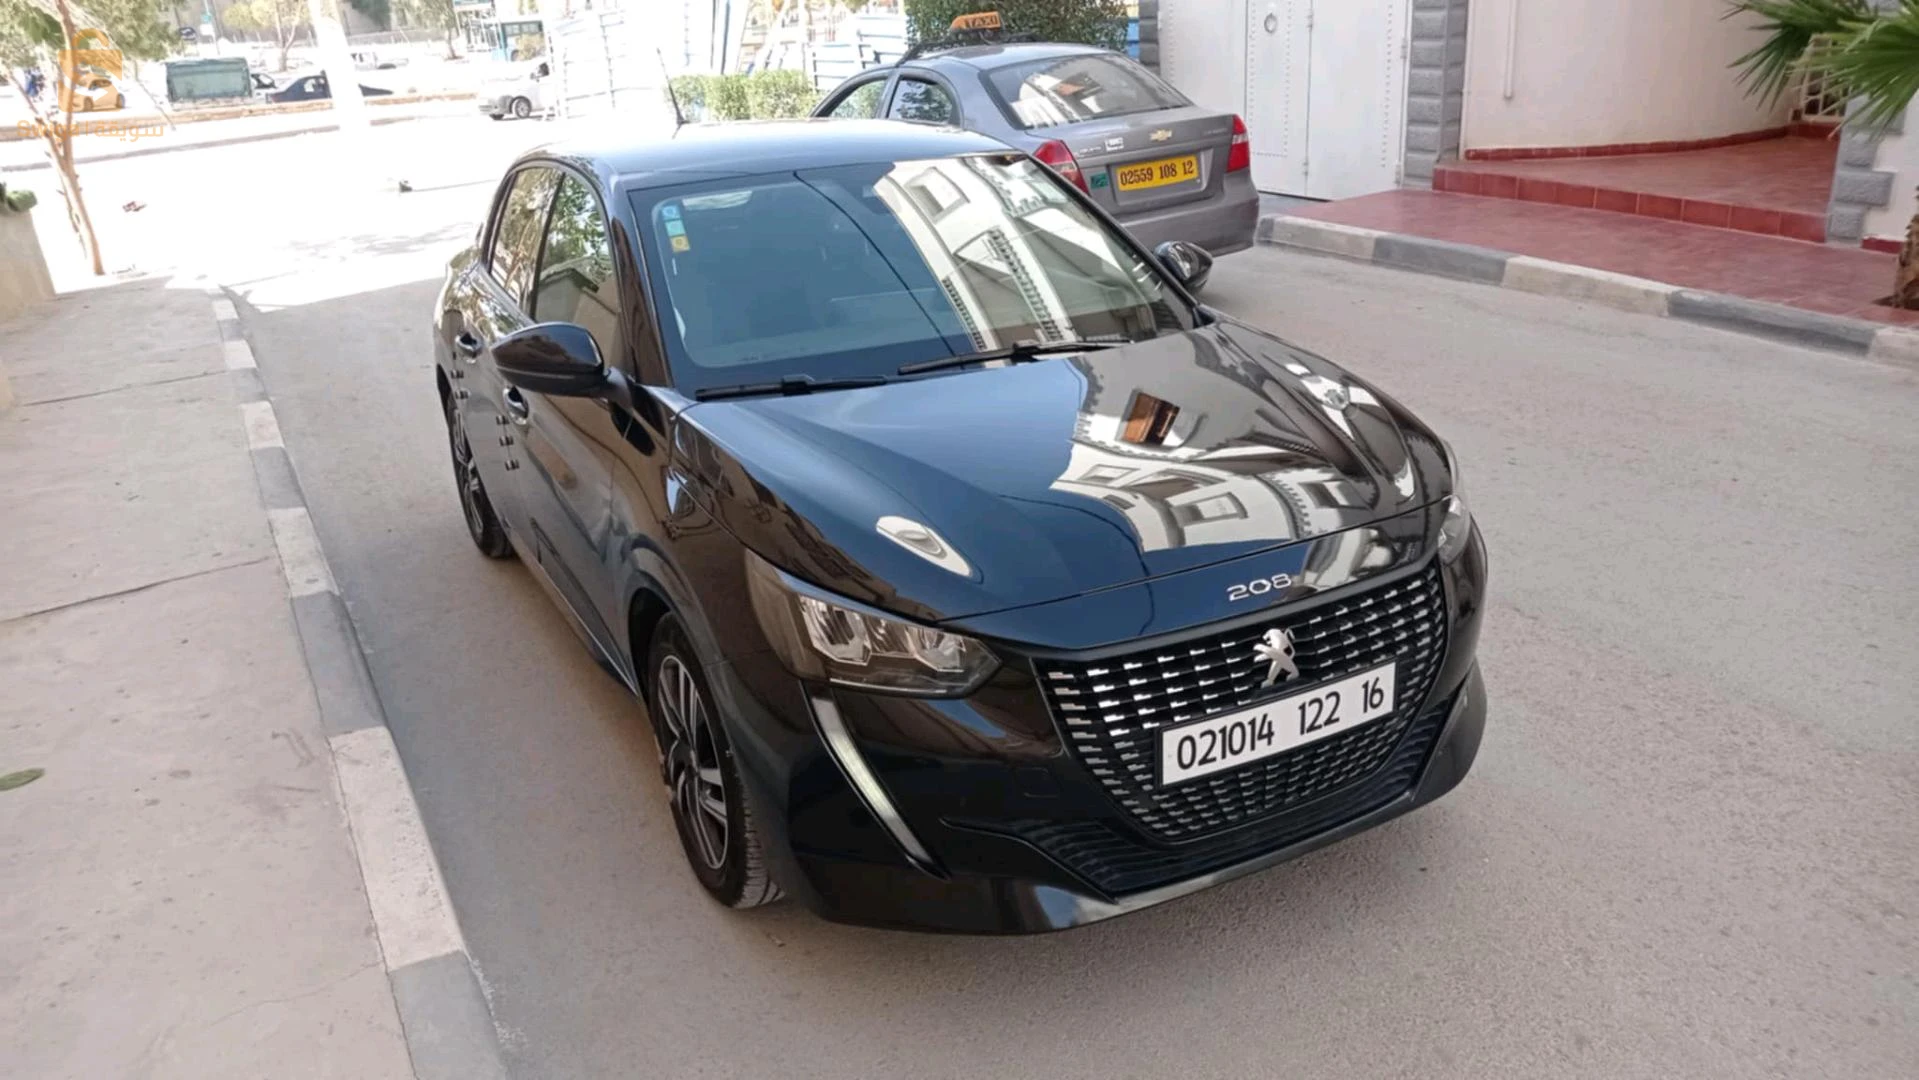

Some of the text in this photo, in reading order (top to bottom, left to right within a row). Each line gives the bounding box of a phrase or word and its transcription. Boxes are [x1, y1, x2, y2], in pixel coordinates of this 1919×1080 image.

[1120, 160, 1194, 186] 02559 108 12
[1226, 573, 1292, 601] 208
[1177, 677, 1384, 770] 021014 122 16
